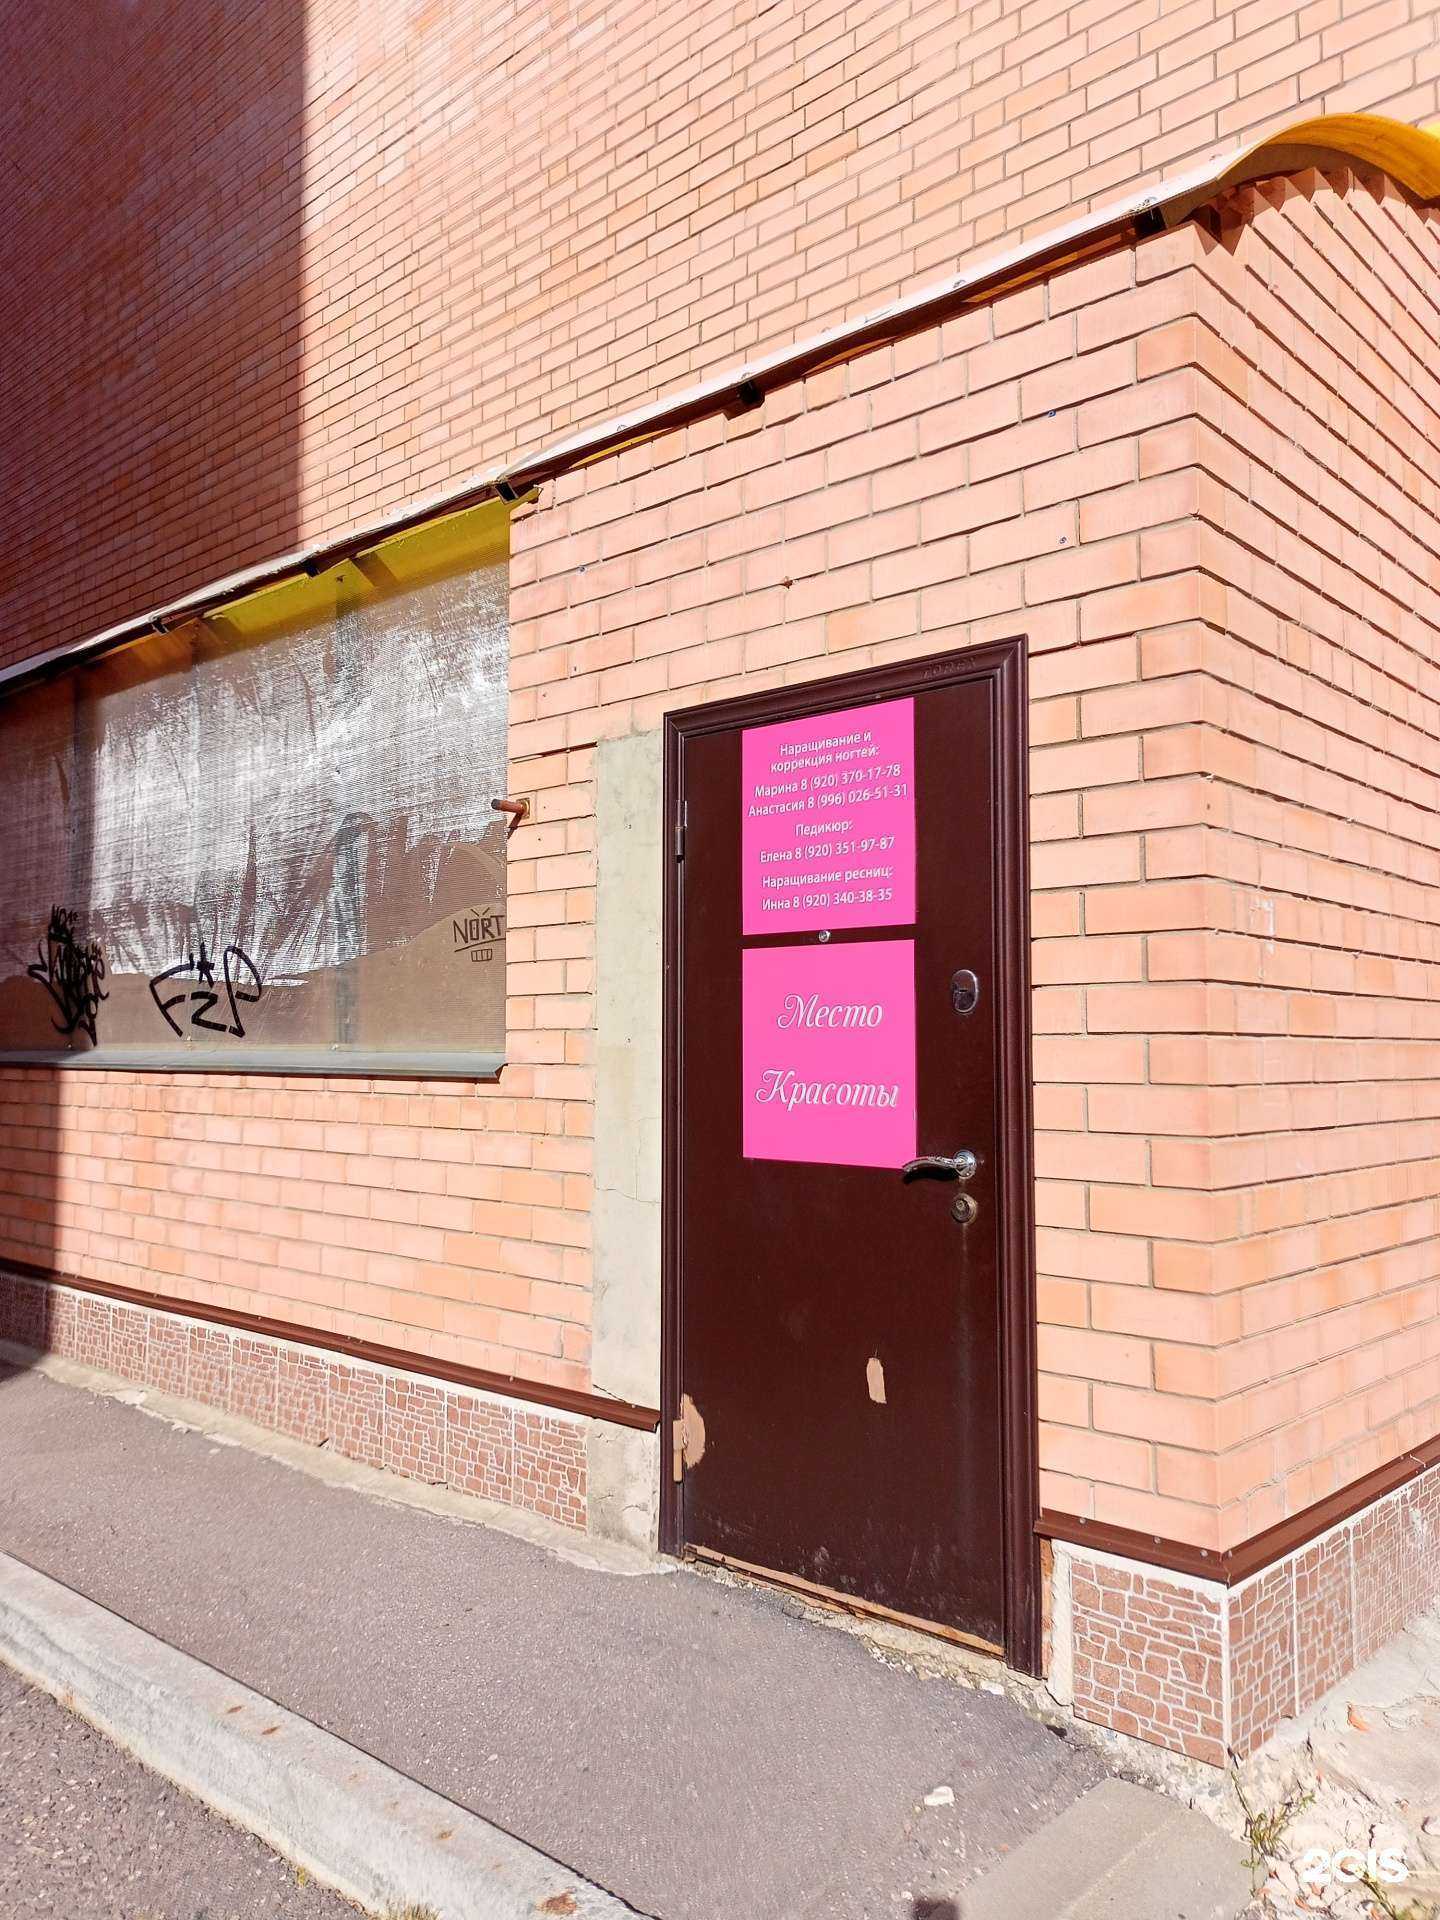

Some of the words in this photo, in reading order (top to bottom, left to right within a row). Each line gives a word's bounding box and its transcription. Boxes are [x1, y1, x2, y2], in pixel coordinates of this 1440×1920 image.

[780, 732, 861, 757] Наращивание
[863, 731, 872, 743] и
[770, 753, 833, 774] коррекция
[835, 744, 879, 763] ногтей:
[754, 782, 798, 798] Марина
[800, 778, 808, 791] 8
[810, 773, 838, 791] (920)
[840, 764, 901, 785] 370-17-78
[748, 799, 805, 818] Анастасия
[807, 796, 815, 809] 8
[817, 791, 846, 808] (996)
[848, 783, 908, 804] 026-51-31
[795, 820, 854, 837] Педикюр:
[760, 850, 793, 864] Елена
[795, 847, 802, 860] 8
[804, 843, 832, 860] (920)
[835, 836, 895, 856] 351-97-87
[762, 871, 841, 891] Наращивание
[844, 865, 894, 884] ресниц:
[762, 898, 791, 912] Инна
[792, 895, 800, 909] 8
[802, 892, 830, 910] (920)
[832, 887, 893, 906] 340-38-35
[776, 993, 883, 1029] Место
[755, 1068, 899, 1112] Красоты
